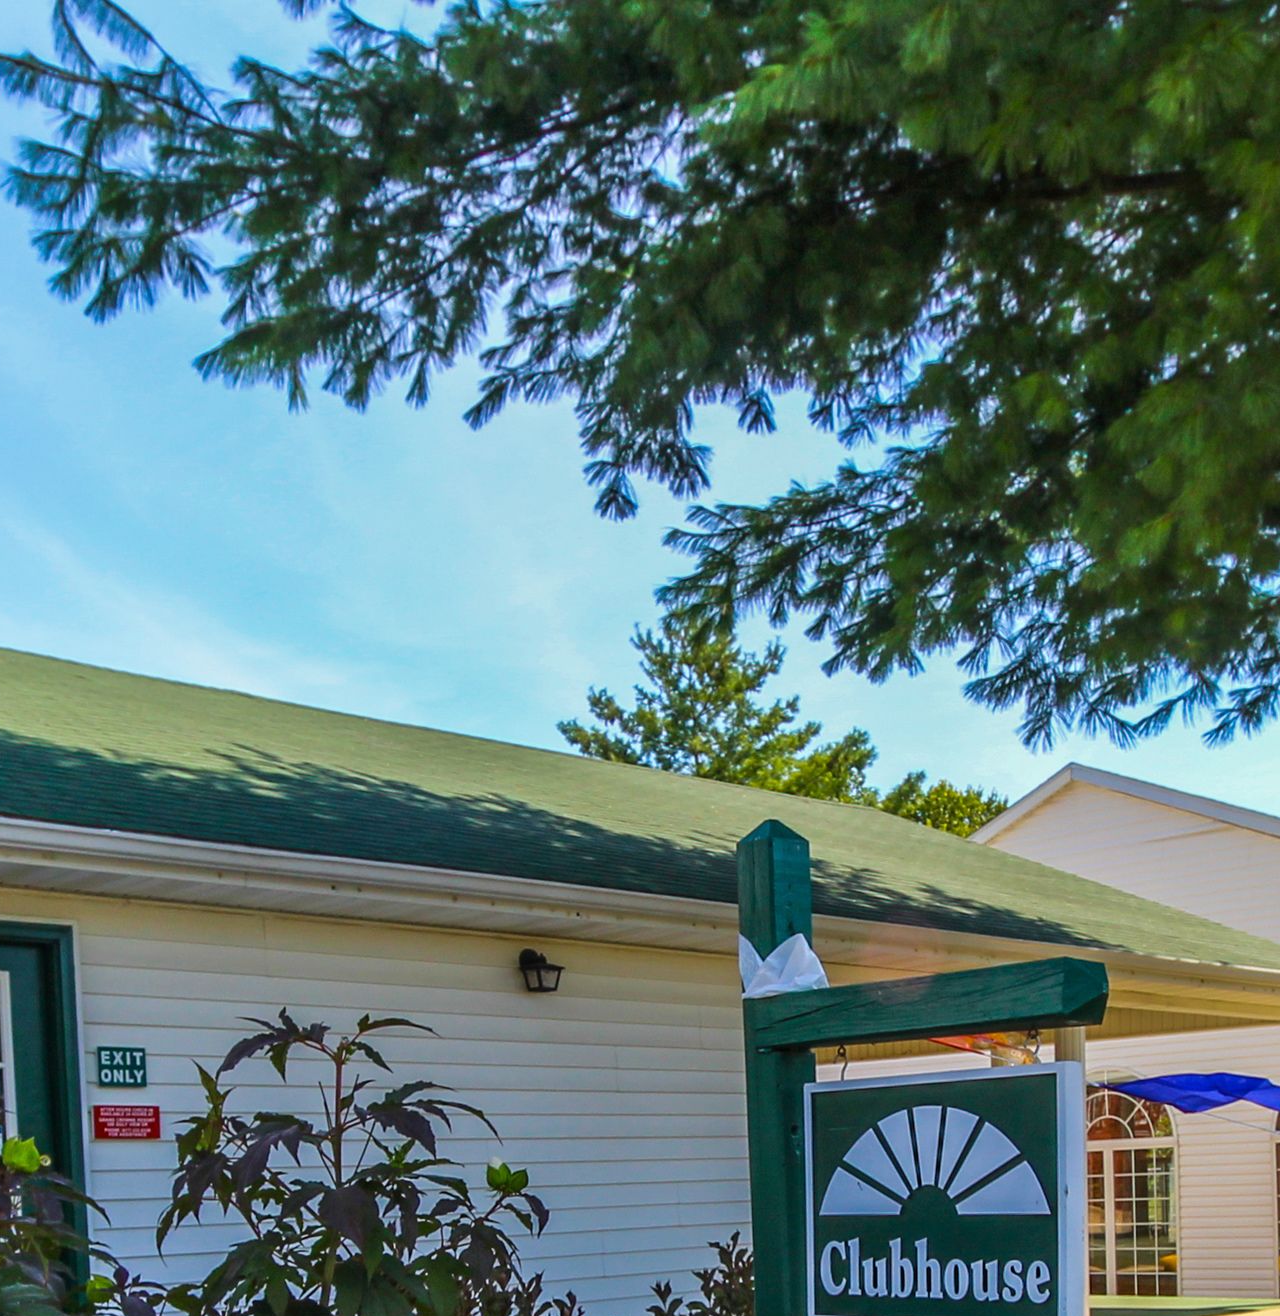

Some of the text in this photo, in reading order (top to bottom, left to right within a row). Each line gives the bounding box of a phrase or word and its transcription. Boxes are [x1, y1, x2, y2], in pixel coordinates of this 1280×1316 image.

[100, 1050, 143, 1066] EXIT
[100, 1069, 145, 1083] ONLY
[820, 1236, 1051, 1304] Clubhouse
